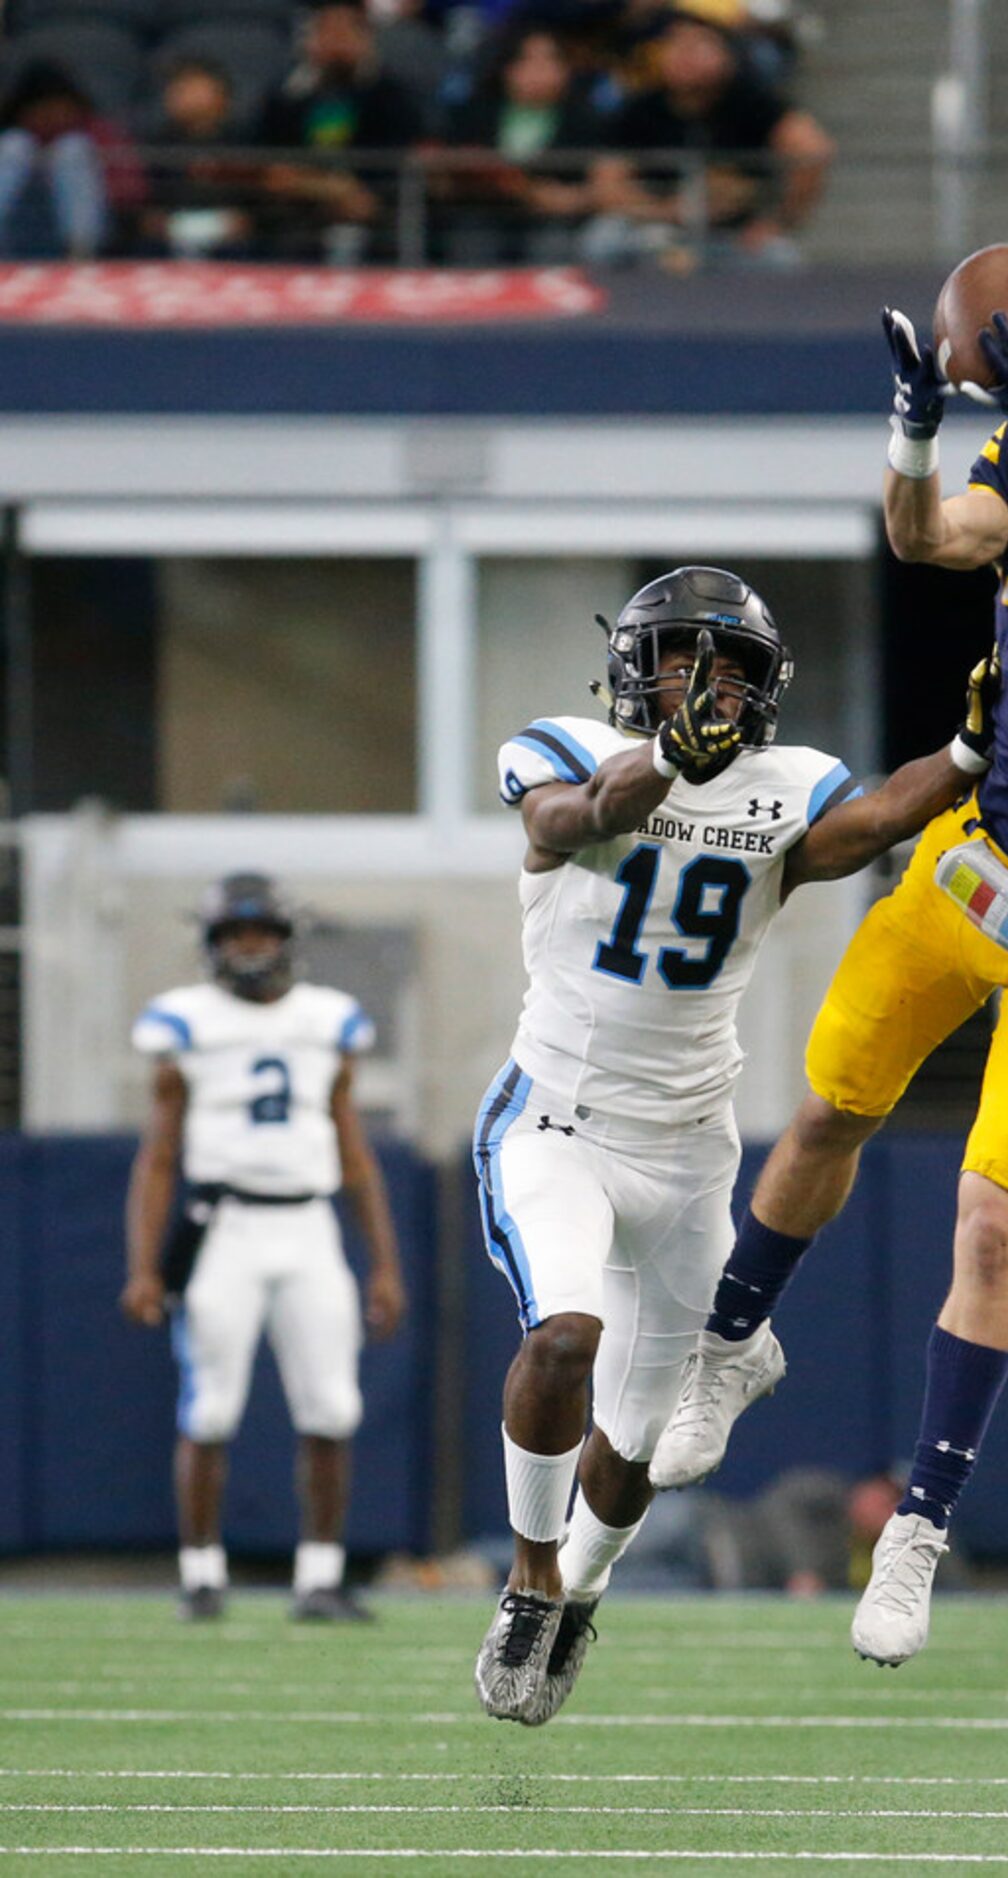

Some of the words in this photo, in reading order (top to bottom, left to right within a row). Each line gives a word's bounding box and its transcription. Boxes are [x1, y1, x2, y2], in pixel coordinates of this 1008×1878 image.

[702, 826, 776, 854] CREEK
[591, 841, 752, 990] 19
[250, 1054, 291, 1125] 2
